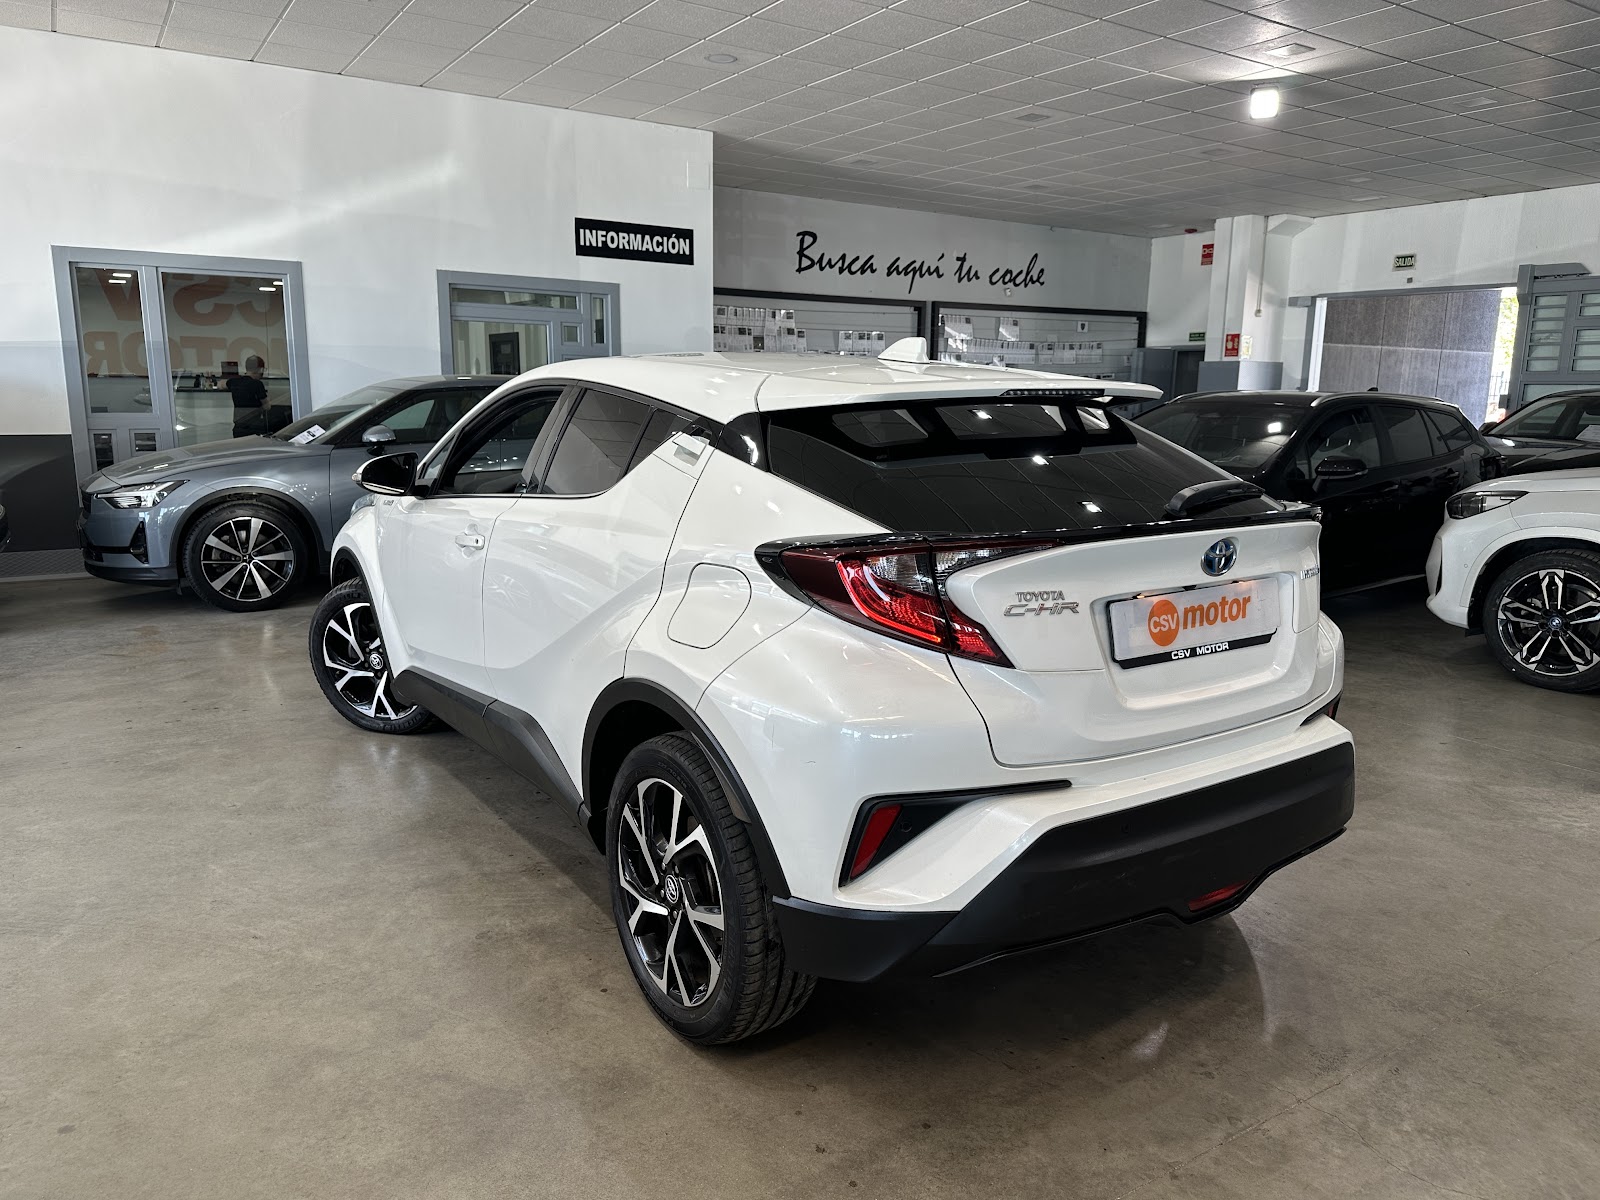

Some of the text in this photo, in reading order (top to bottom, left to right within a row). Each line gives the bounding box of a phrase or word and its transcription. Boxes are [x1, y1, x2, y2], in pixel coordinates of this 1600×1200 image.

[579, 228, 690, 256] INFORMACIÓN
[795, 230, 1045, 294] Busca aquí tu coche
[1394, 257, 1415, 267] SALIDA
[1015, 590, 1065, 602] TOYOTA
[1004, 602, 1079, 617] C-HR
[1150, 596, 1251, 633] CSV motor
[1171, 642, 1229, 660] CSV MOTOR
